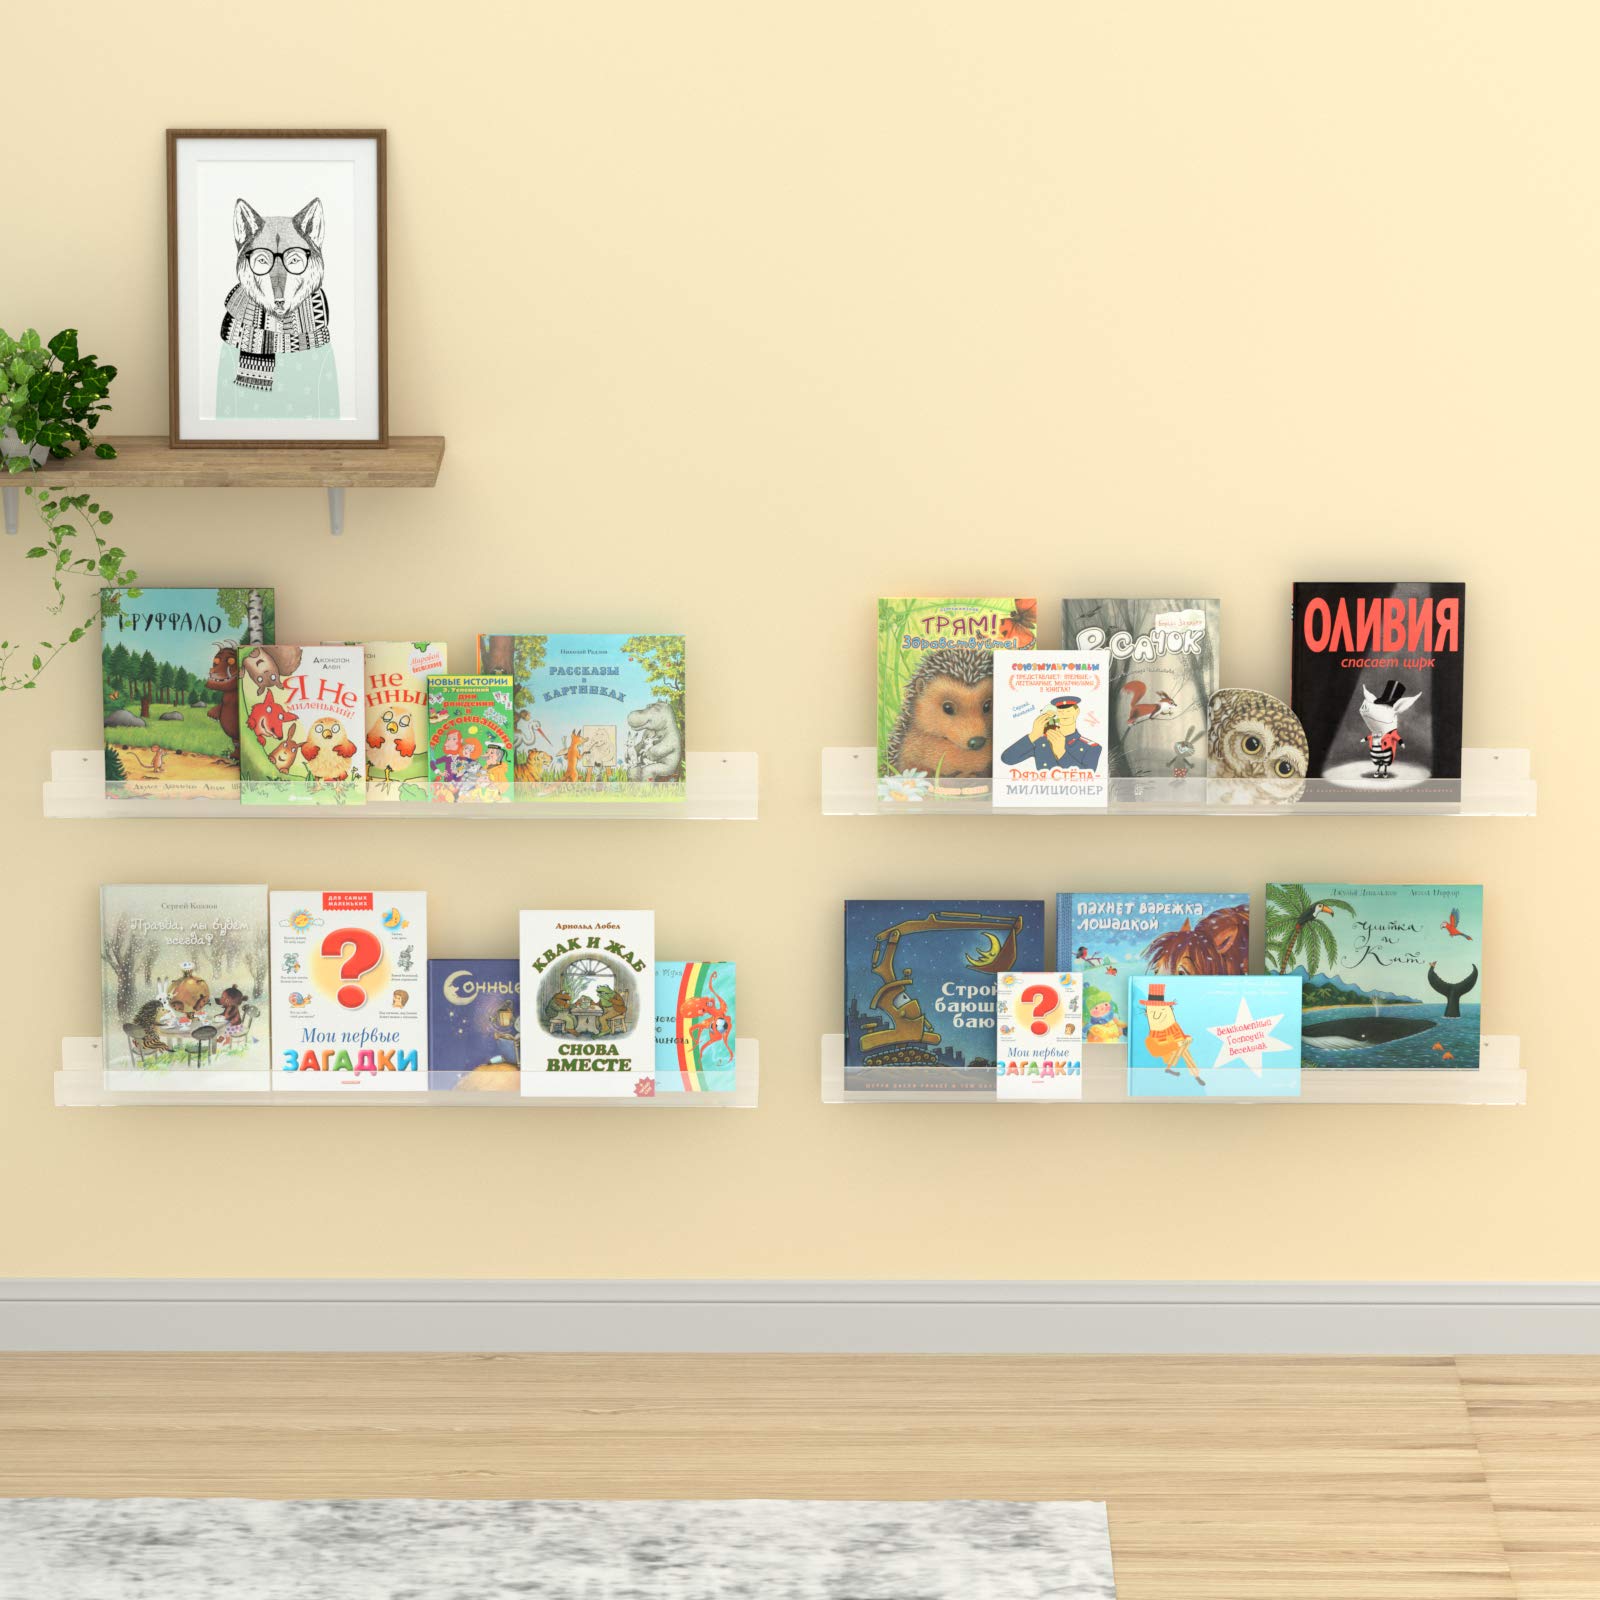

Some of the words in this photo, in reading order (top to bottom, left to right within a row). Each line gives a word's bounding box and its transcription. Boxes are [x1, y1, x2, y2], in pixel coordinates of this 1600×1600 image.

[921, 614, 996, 635] ТРЯМ!
[1304, 597, 1460, 652] ОЛИВИЯ
[902, 635, 1017, 650] Здравствуйте!
[1075, 626, 1206, 664] РСАЧОК
[549, 666, 620, 676] РАССКАЗЫ
[1340, 658, 1399, 668] спасает
[1403, 658, 1436, 671] цирк
[428, 678, 462, 686] НОВЫЕ
[464, 678, 508, 686] ИСТОРИИ
[282, 674, 310, 704] Я
[317, 678, 358, 709] Не
[542, 685, 627, 703] КАРТИНКАХ
[286, 702, 356, 720] миленький!
[1006, 784, 1104, 796] МИЛИЦИОНЕР
[161, 902, 188, 911] Сергей
[190, 902, 218, 910] Козлов
[130, 918, 184, 935] Правда,
[190, 921, 208, 930] мы
[212, 918, 249, 936] будем
[555, 922, 592, 930] Арнольд
[594, 922, 621, 930] Лобел
[166, 932, 214, 946] всегда?
[532, 937, 582, 974] КВАК
[586, 936, 601, 948] И
[604, 940, 646, 973] ЖАБ
[934, 996, 995, 1012] баюш
[952, 1012, 995, 1028] баю
[301, 1027, 336, 1043] Мои
[341, 1026, 400, 1048] первые
[558, 1044, 620, 1056] СНОВА
[1008, 1047, 1030, 1058] Мои
[1032, 1047, 1070, 1060] первые
[282, 1049, 418, 1077] ЗАГАДКИ
[546, 1058, 632, 1072] ВМЕСТЕ
[996, 1060, 1081, 1078] ЗАГАДКИ
